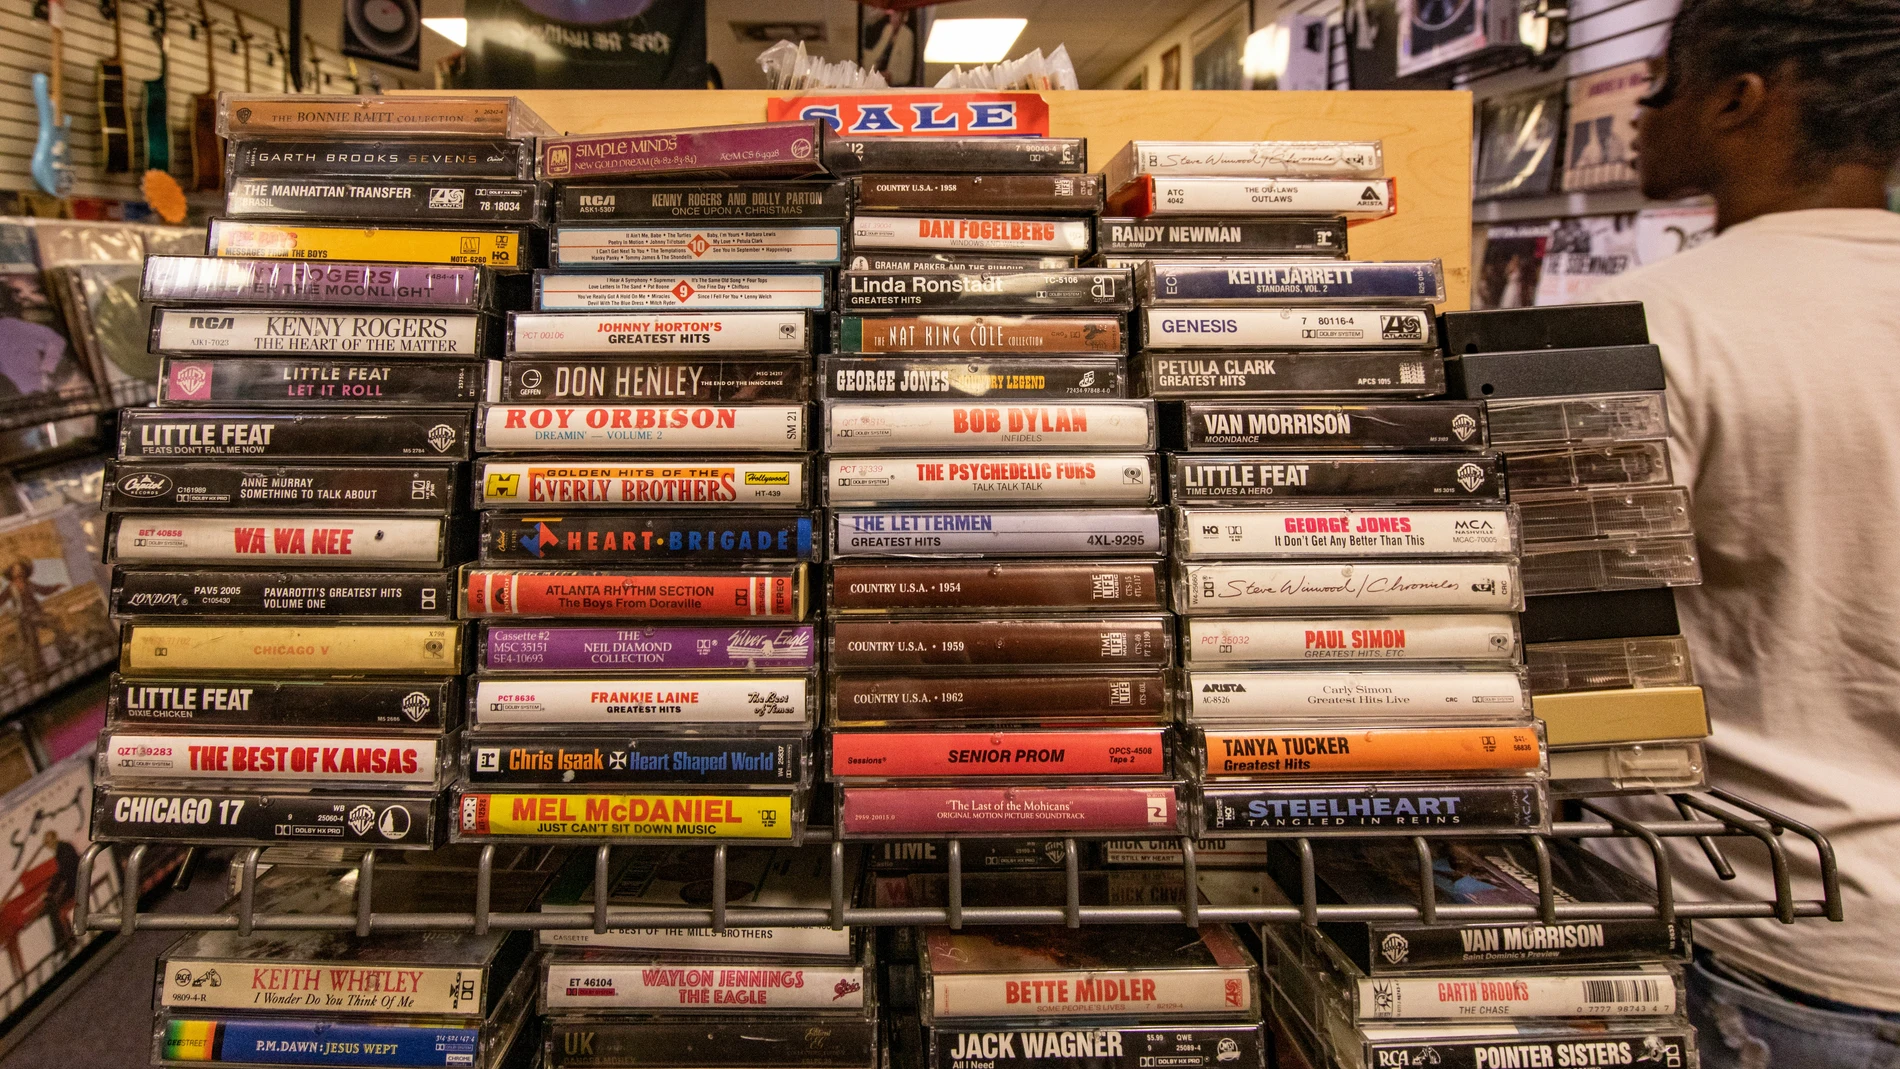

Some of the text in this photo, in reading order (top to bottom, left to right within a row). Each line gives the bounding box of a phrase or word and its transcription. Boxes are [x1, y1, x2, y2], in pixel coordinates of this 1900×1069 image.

[800, 102, 1017, 132] SALE
[631, 137, 677, 153] MINDS
[260, 153, 477, 163] GARTH BROOKS SEVENS
[244, 185, 412, 198] THE MANHATTAN TRANSFER
[652, 192, 822, 206] KENNY ROGERS AND DOLLY PARTON
[672, 206, 802, 216] ONCE UPON A CHRISTMAS
[919, 220, 1054, 240] DAN FOGELBERG
[1112, 227, 1241, 242] RANDY NEWMAN
[690, 240, 705, 252] 10
[1228, 267, 1354, 284] KEITH JARRETT
[851, 278, 1002, 293] Linda Ronstadt
[266, 317, 446, 337] KENNY ROGERS
[1162, 320, 1237, 333] GENESIS
[283, 368, 390, 380] LITTLE FEAT
[1159, 361, 1275, 375] PETULA CLARK
[556, 366, 703, 396] DON HENLEY
[837, 371, 1045, 391] GEORGE JONES LEGEND
[1160, 376, 1246, 386] GREATEST HITS
[288, 385, 382, 396] LET IT ROLL
[505, 409, 737, 429] ROY ORBISON
[953, 408, 1087, 433] BOB DYLAN
[227, 446, 240, 454] ME
[243, 446, 265, 454] NOW
[690, 469, 719, 477] THE
[917, 463, 1095, 481] THE PSYCHEDELIC FURS
[240, 490, 377, 499] SOMETHING TO TALK ABOUT
[528, 472, 736, 502] EVERLY BROTHERS
[852, 515, 992, 531] THE LETTERMEN
[1285, 518, 1411, 532] GEORGE JONES
[235, 528, 353, 554] WA WA NEE
[568, 532, 788, 550] HEART BRIGADE
[265, 588, 402, 598] PAVAROTTI'S GREATEST HITS
[546, 585, 714, 596] ATLANTA RHYTHM SECTION
[264, 599, 325, 608] VOLUME ONE
[558, 598, 701, 609] The Boys From Doraville
[495, 631, 549, 640] Cassette #2
[1305, 630, 1405, 648] PAUL SIMON
[128, 688, 252, 710] LITTLE FEAT
[118, 748, 172, 756] QZT 39283
[1223, 737, 1349, 756] TANYA TUCKER
[188, 746, 417, 774] THE BEST OF KANSAS
[510, 749, 773, 774] Chris Isaak Heart Shaped World
[948, 749, 1065, 763] SENIOR PROM
[1224, 759, 1310, 771] Greatest Hits
[115, 797, 244, 824] CHICAGO 17
[512, 798, 742, 823] MEL McDANIEL
[946, 800, 1073, 811] "The Last of the Mohicans"
[1248, 797, 1460, 816] STEELHEART
[537, 824, 716, 834] JUST CAN'T SIT DOWN MUSIC
[1461, 924, 1604, 952] VAN MORRISON
[252, 968, 423, 992] KEITH WHITLEY
[642, 970, 804, 987] WAYLON JENNINGS
[679, 990, 767, 1004] THE EAGLE
[1006, 979, 1156, 1004] BETTE MIDLER
[1438, 982, 1528, 1002] GARTH BROOKS
[254, 993, 414, 1008] I Wonder Do You Think Of Me
[951, 1032, 1122, 1059] JACK WAGNER
[1475, 1042, 1632, 1068] POINTER SISTERS
